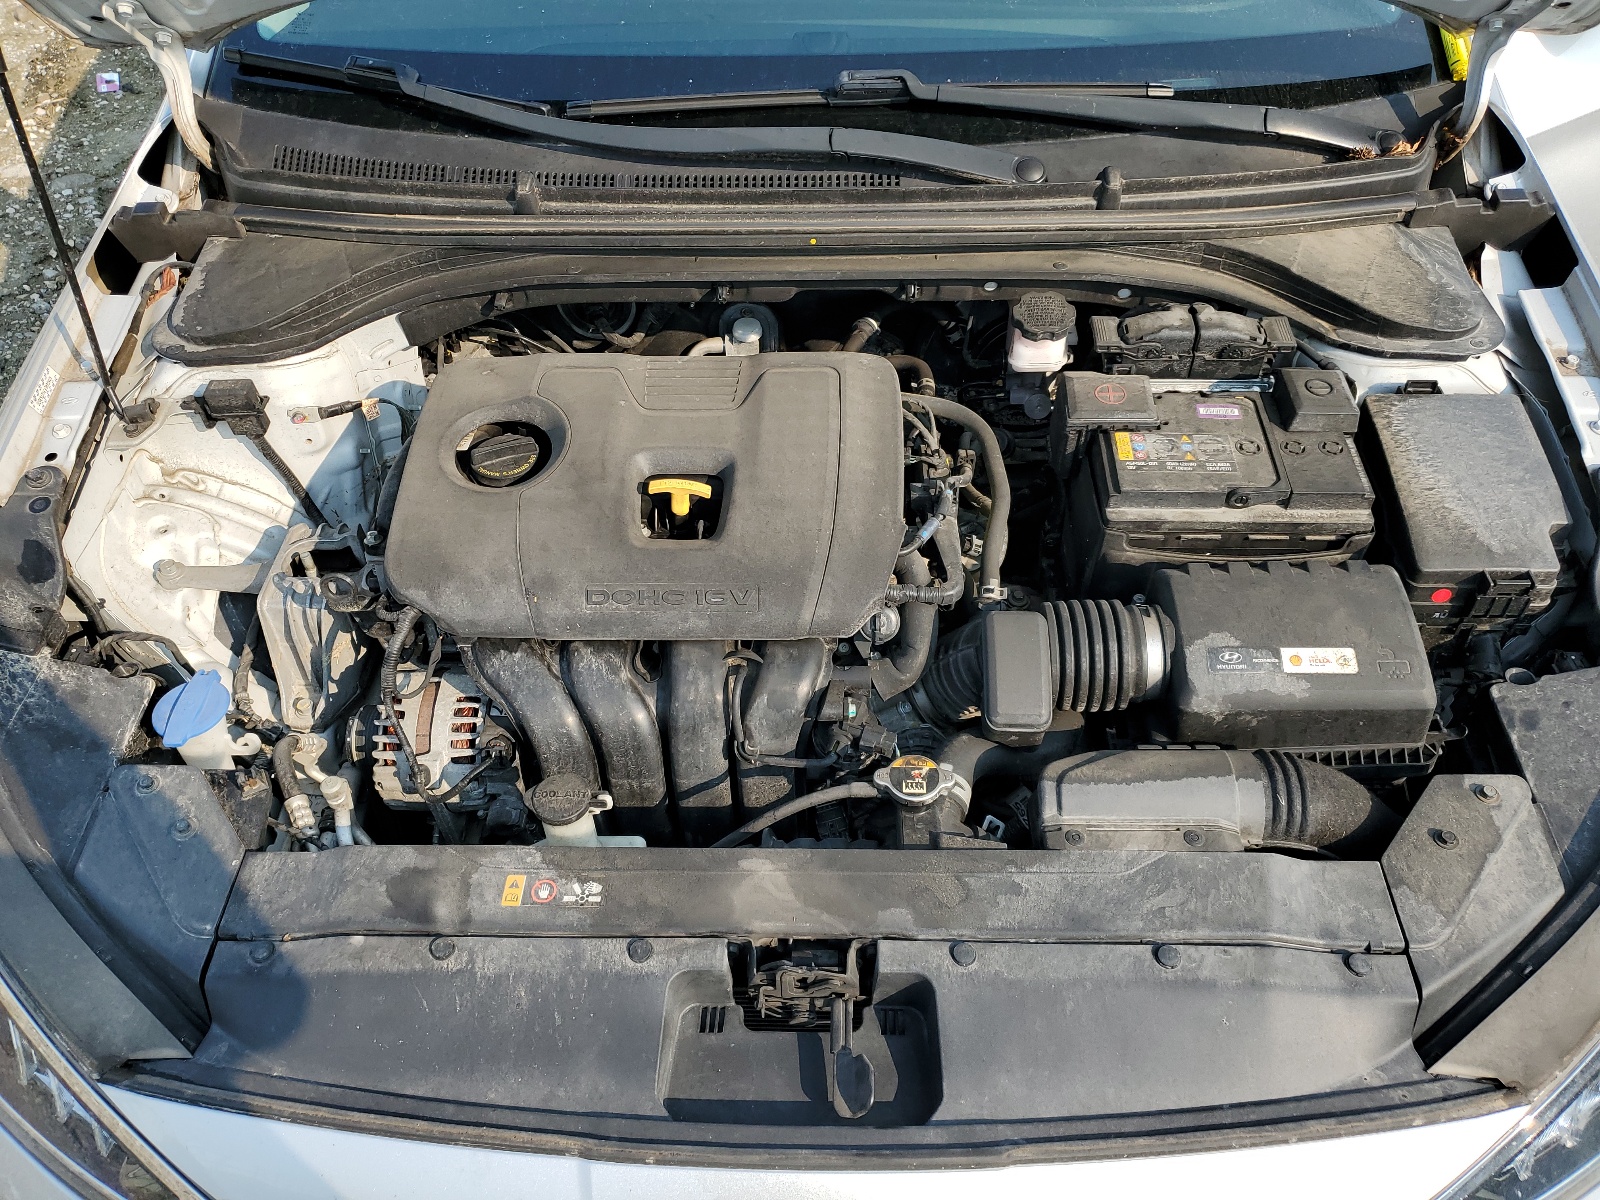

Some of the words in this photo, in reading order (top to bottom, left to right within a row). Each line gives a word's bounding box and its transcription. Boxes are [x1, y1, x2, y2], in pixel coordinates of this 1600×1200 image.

[586, 589, 685, 606] DOHC
[695, 589, 753, 606] 16V
[533, 790, 588, 799] COOLANT
